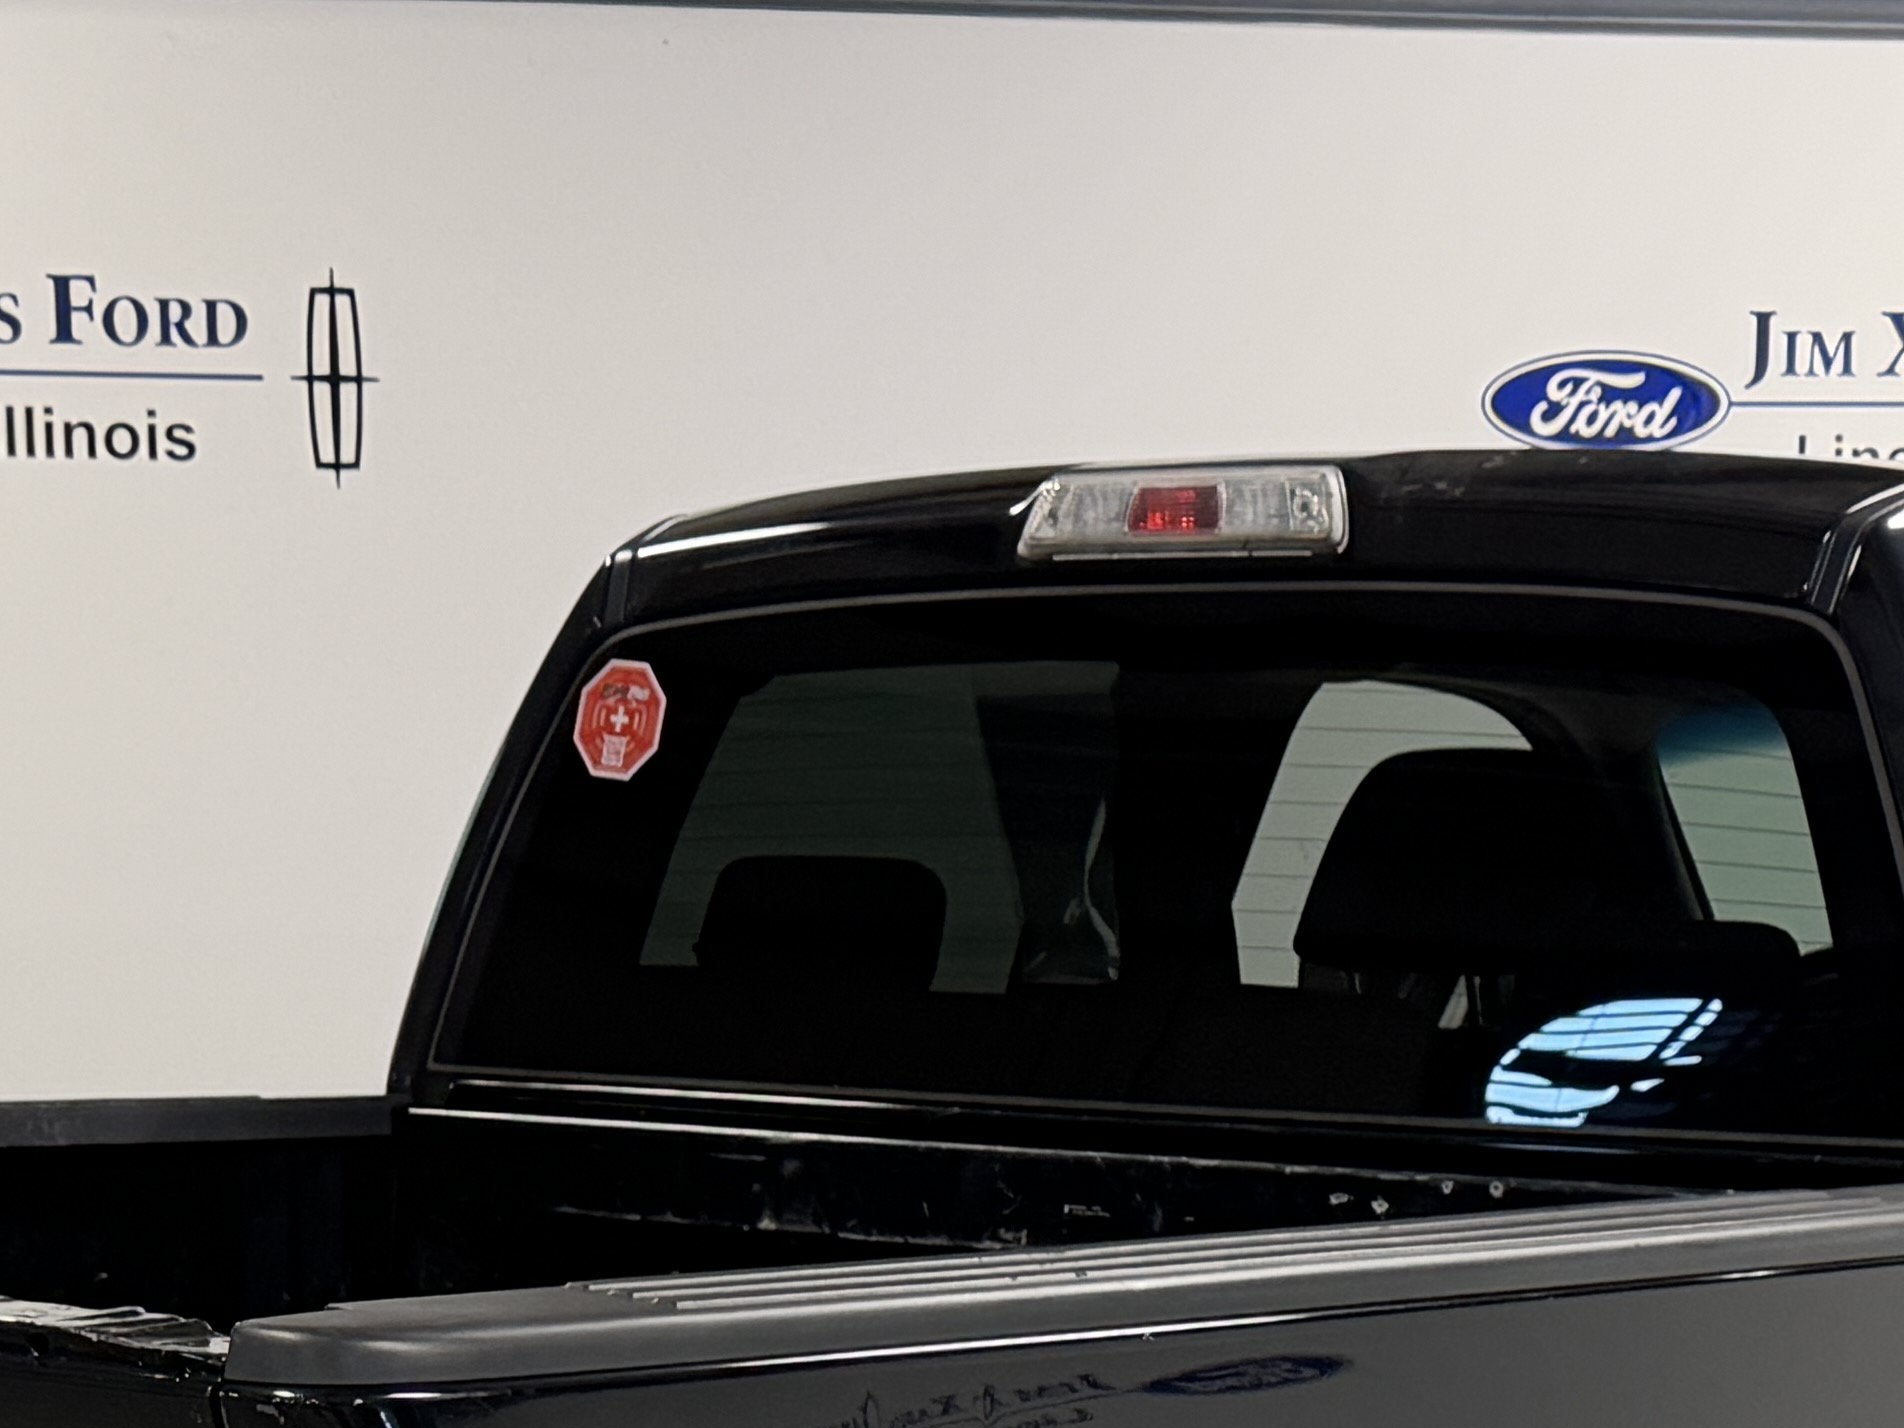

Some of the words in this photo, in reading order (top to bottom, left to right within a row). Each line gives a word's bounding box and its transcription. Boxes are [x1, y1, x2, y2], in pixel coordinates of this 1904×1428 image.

[45, 271, 249, 350] FORD
[1744, 310, 1857, 390] JIM
[1529, 368, 1680, 441] Ford
